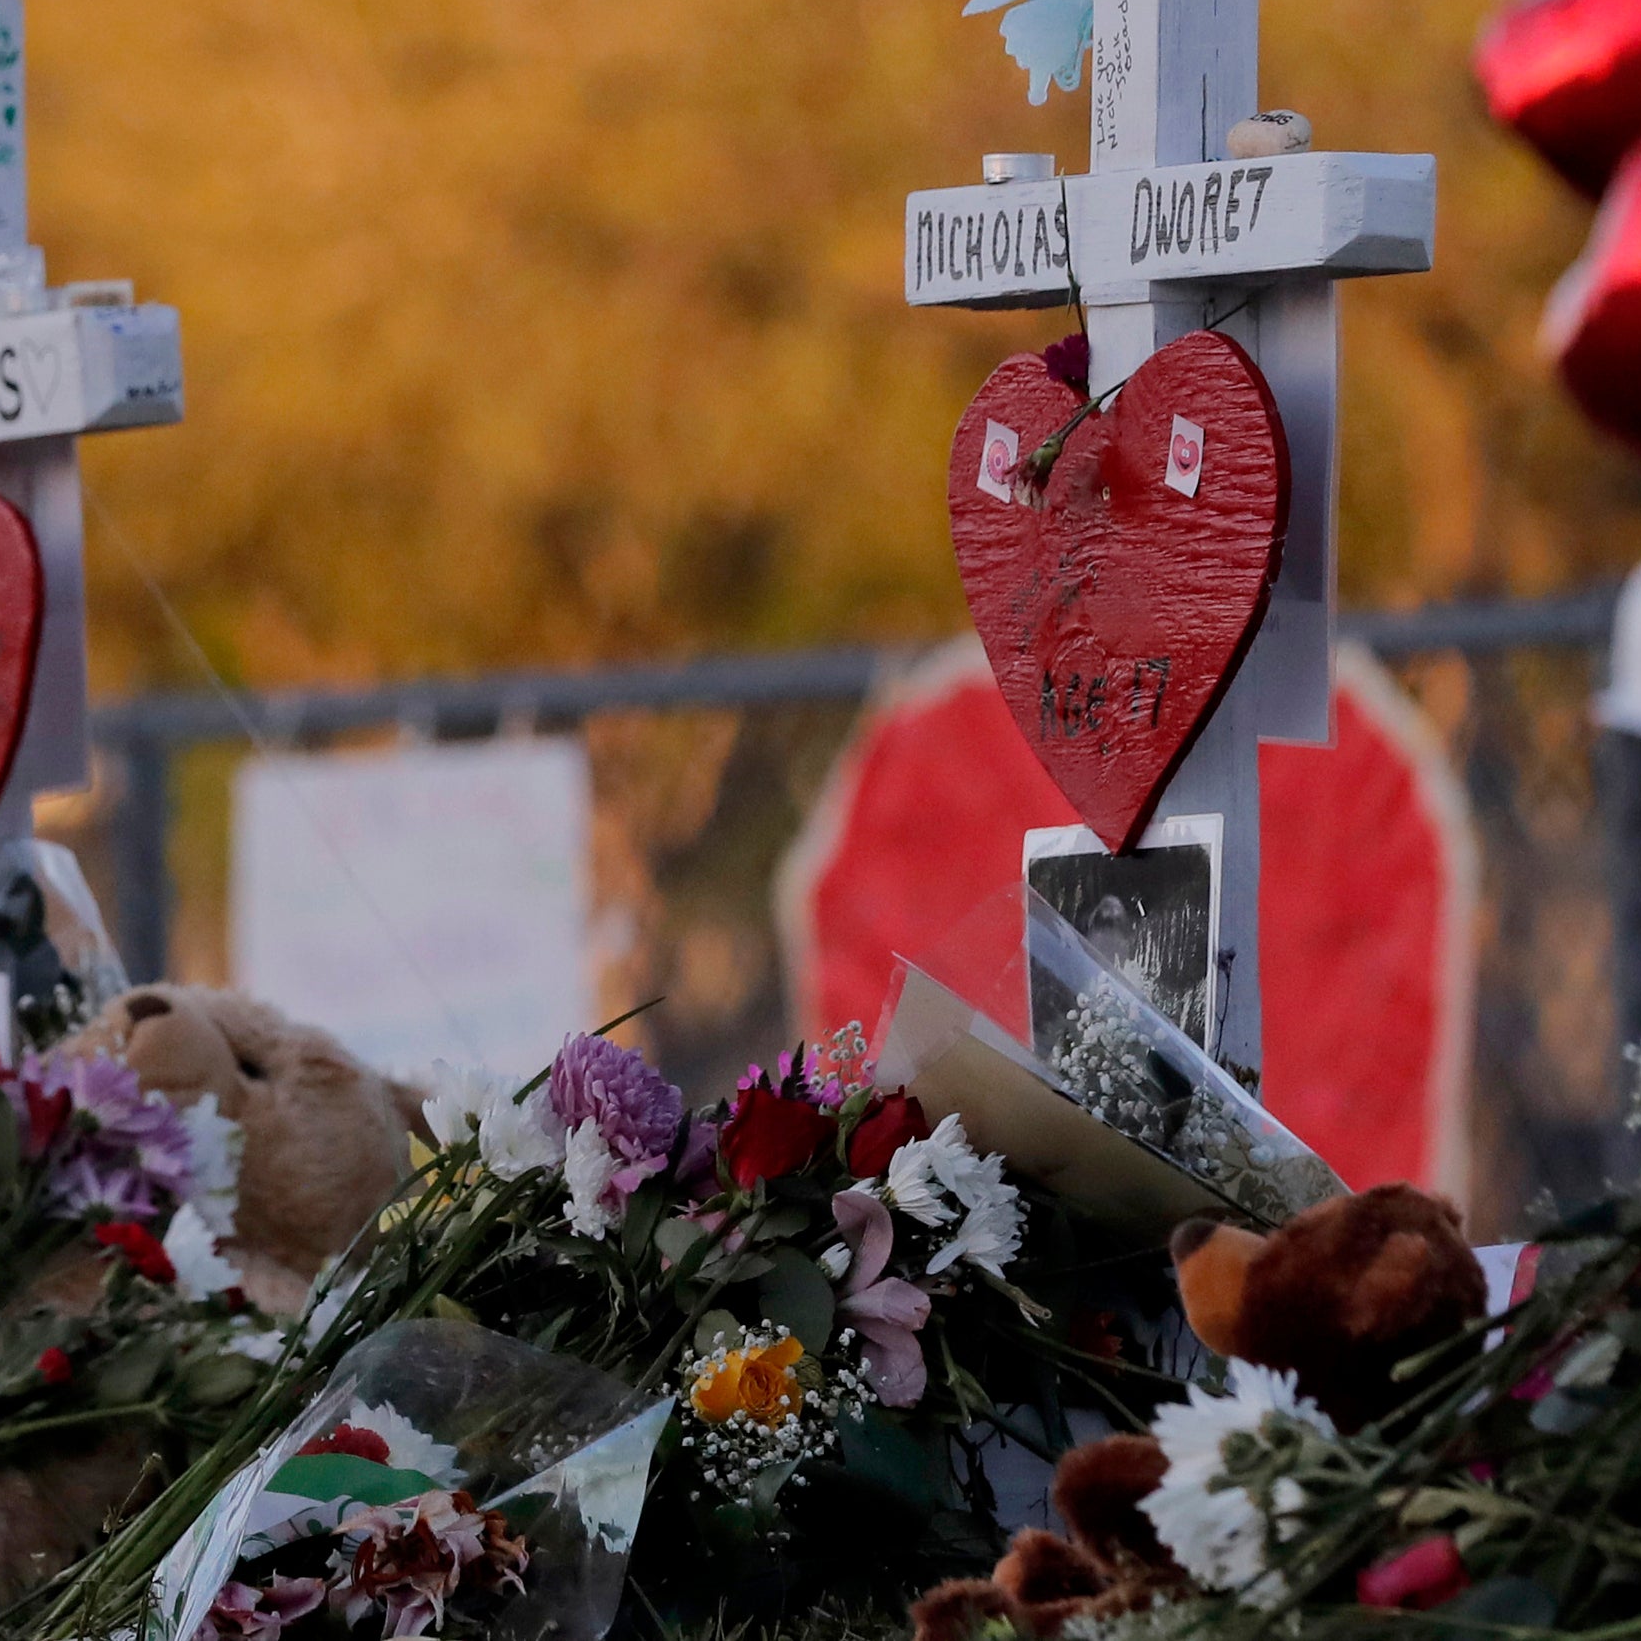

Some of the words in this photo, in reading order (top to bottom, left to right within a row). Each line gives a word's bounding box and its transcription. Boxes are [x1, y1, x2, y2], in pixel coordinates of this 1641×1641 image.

[915, 201, 1070, 291] NICHOLAS
[1130, 166, 1273, 266] DWORET
[1040, 669, 1108, 742] AGE
[1130, 655, 1171, 729] 17
